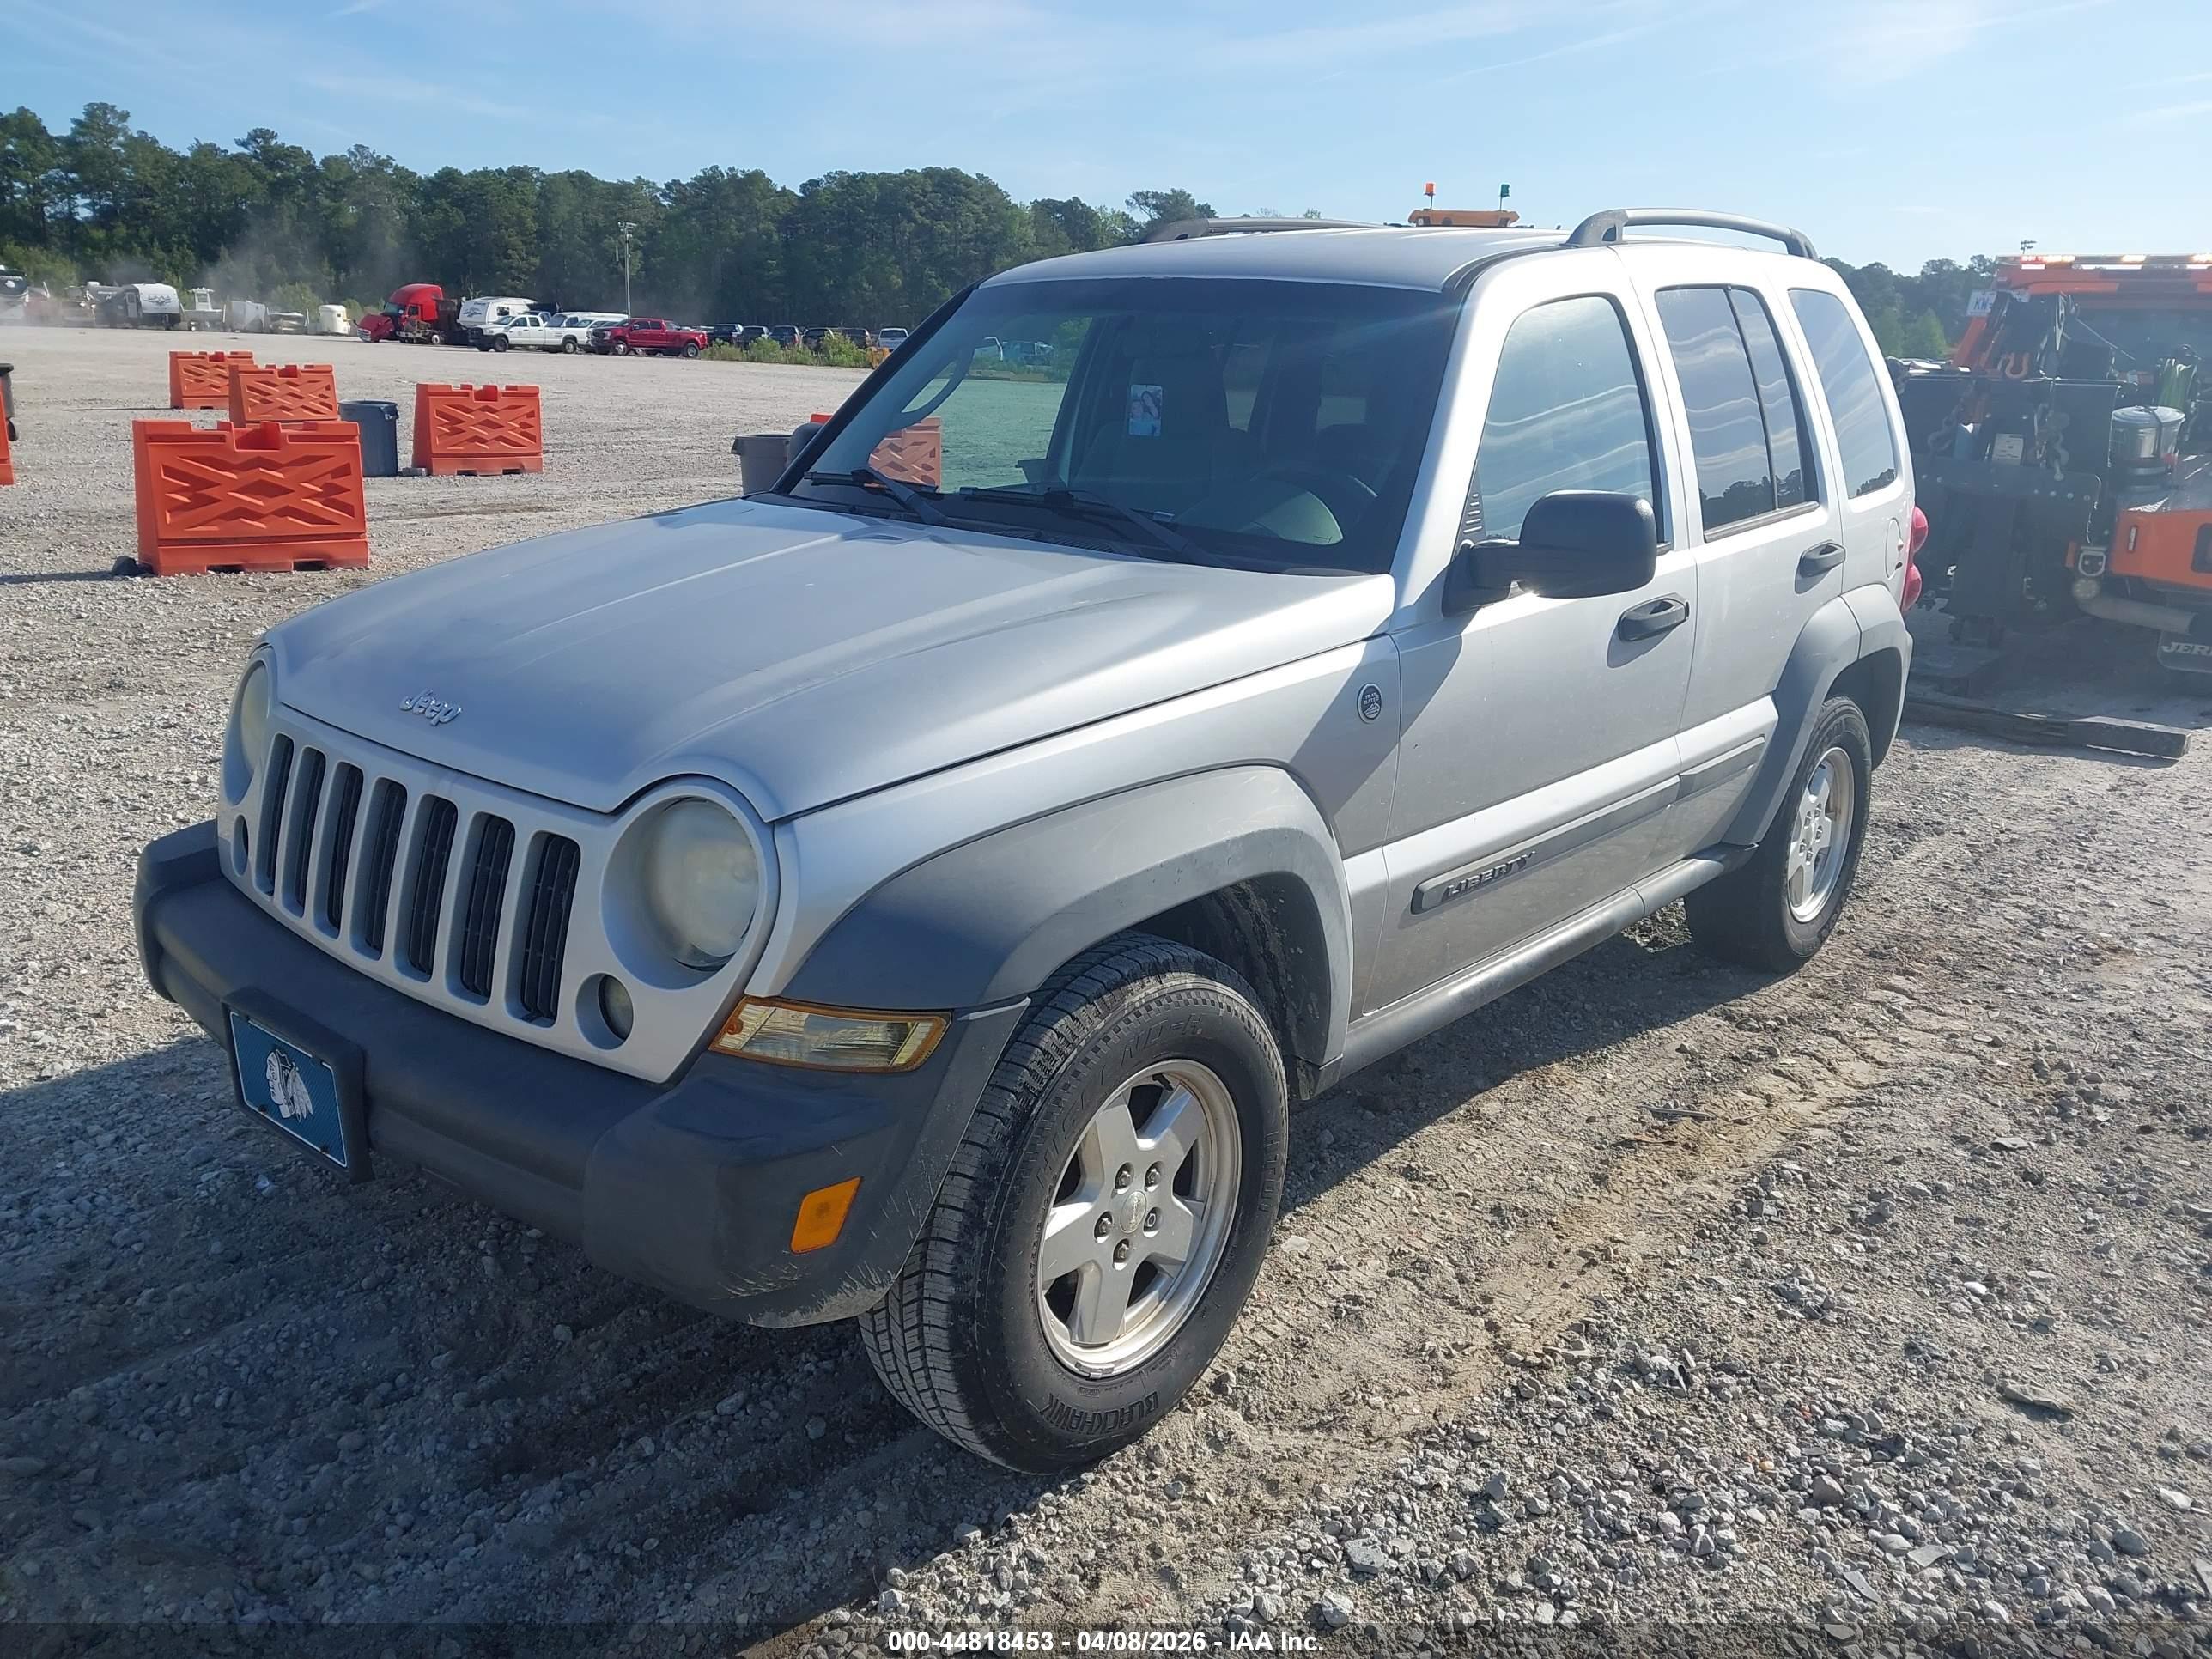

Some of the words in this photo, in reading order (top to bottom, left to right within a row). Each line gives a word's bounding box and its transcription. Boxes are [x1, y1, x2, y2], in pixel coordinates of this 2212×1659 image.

[398, 687, 463, 726] Jeep
[1443, 850, 1536, 900] LIBERTY
[1040, 1390, 1159, 1436] BLACKHAWK
